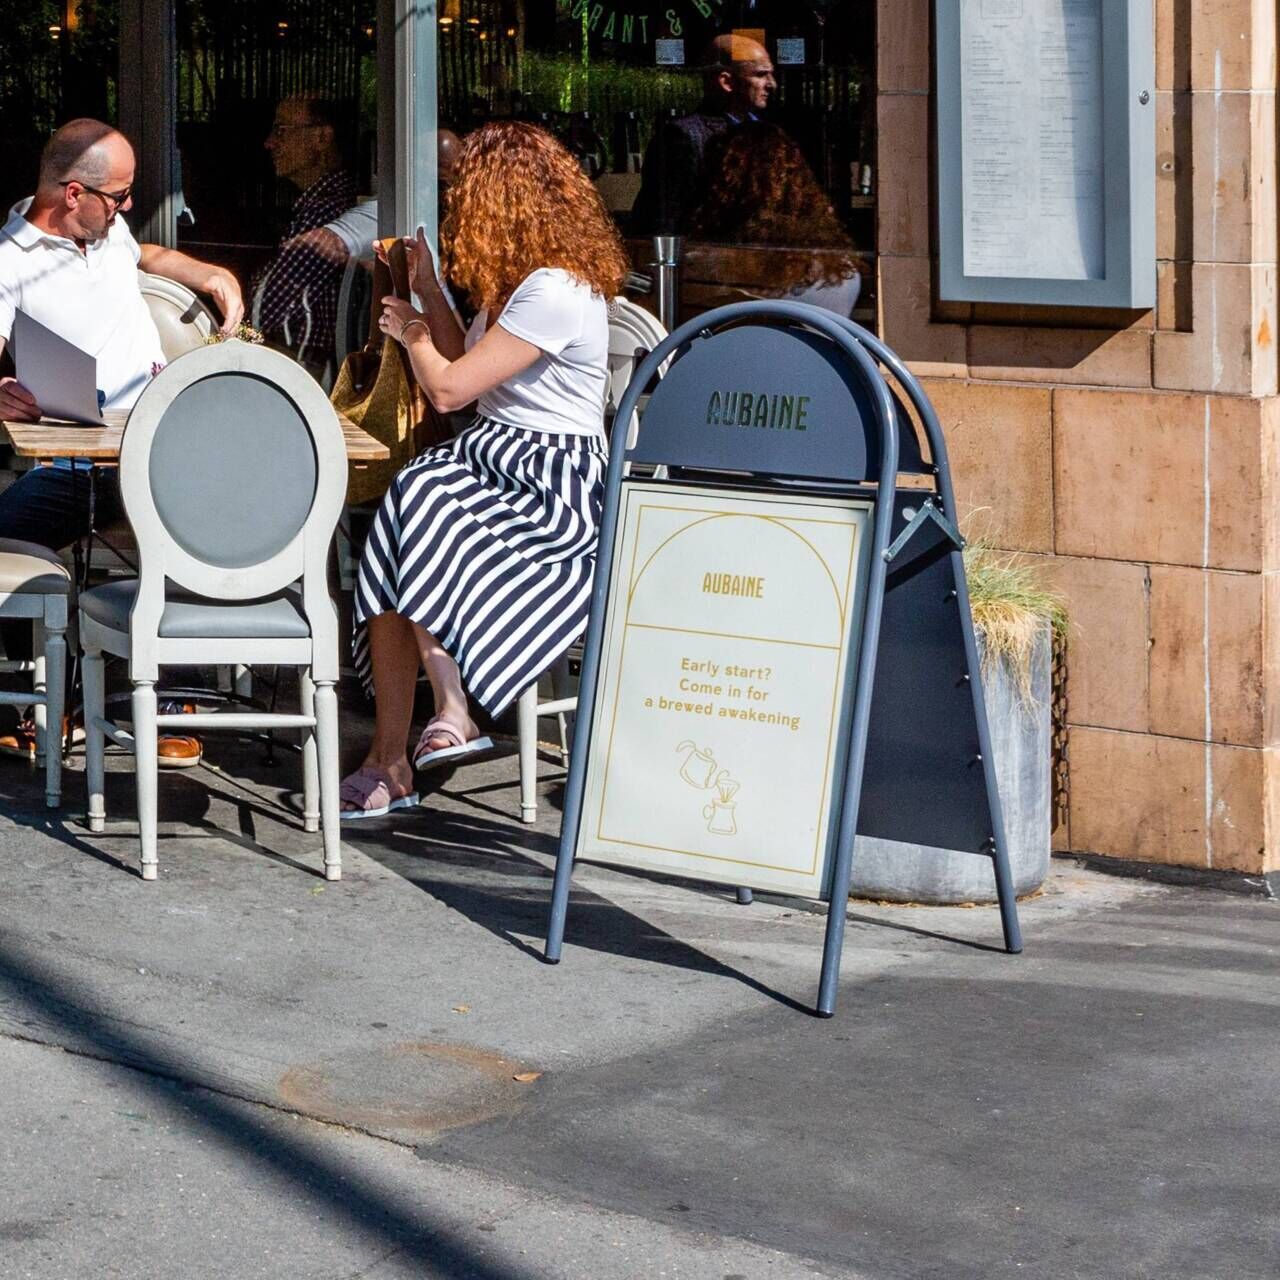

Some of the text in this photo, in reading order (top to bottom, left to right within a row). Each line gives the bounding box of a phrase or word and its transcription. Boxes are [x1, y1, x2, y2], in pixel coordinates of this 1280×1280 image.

[666, 9, 683, 36] &
[706, 390, 811, 431] AUBAINE
[702, 572, 765, 599] AUBAINE
[681, 658, 772, 680] Early start?
[679, 678, 769, 701] Come in for
[644, 696, 801, 731] a brewed awakening
